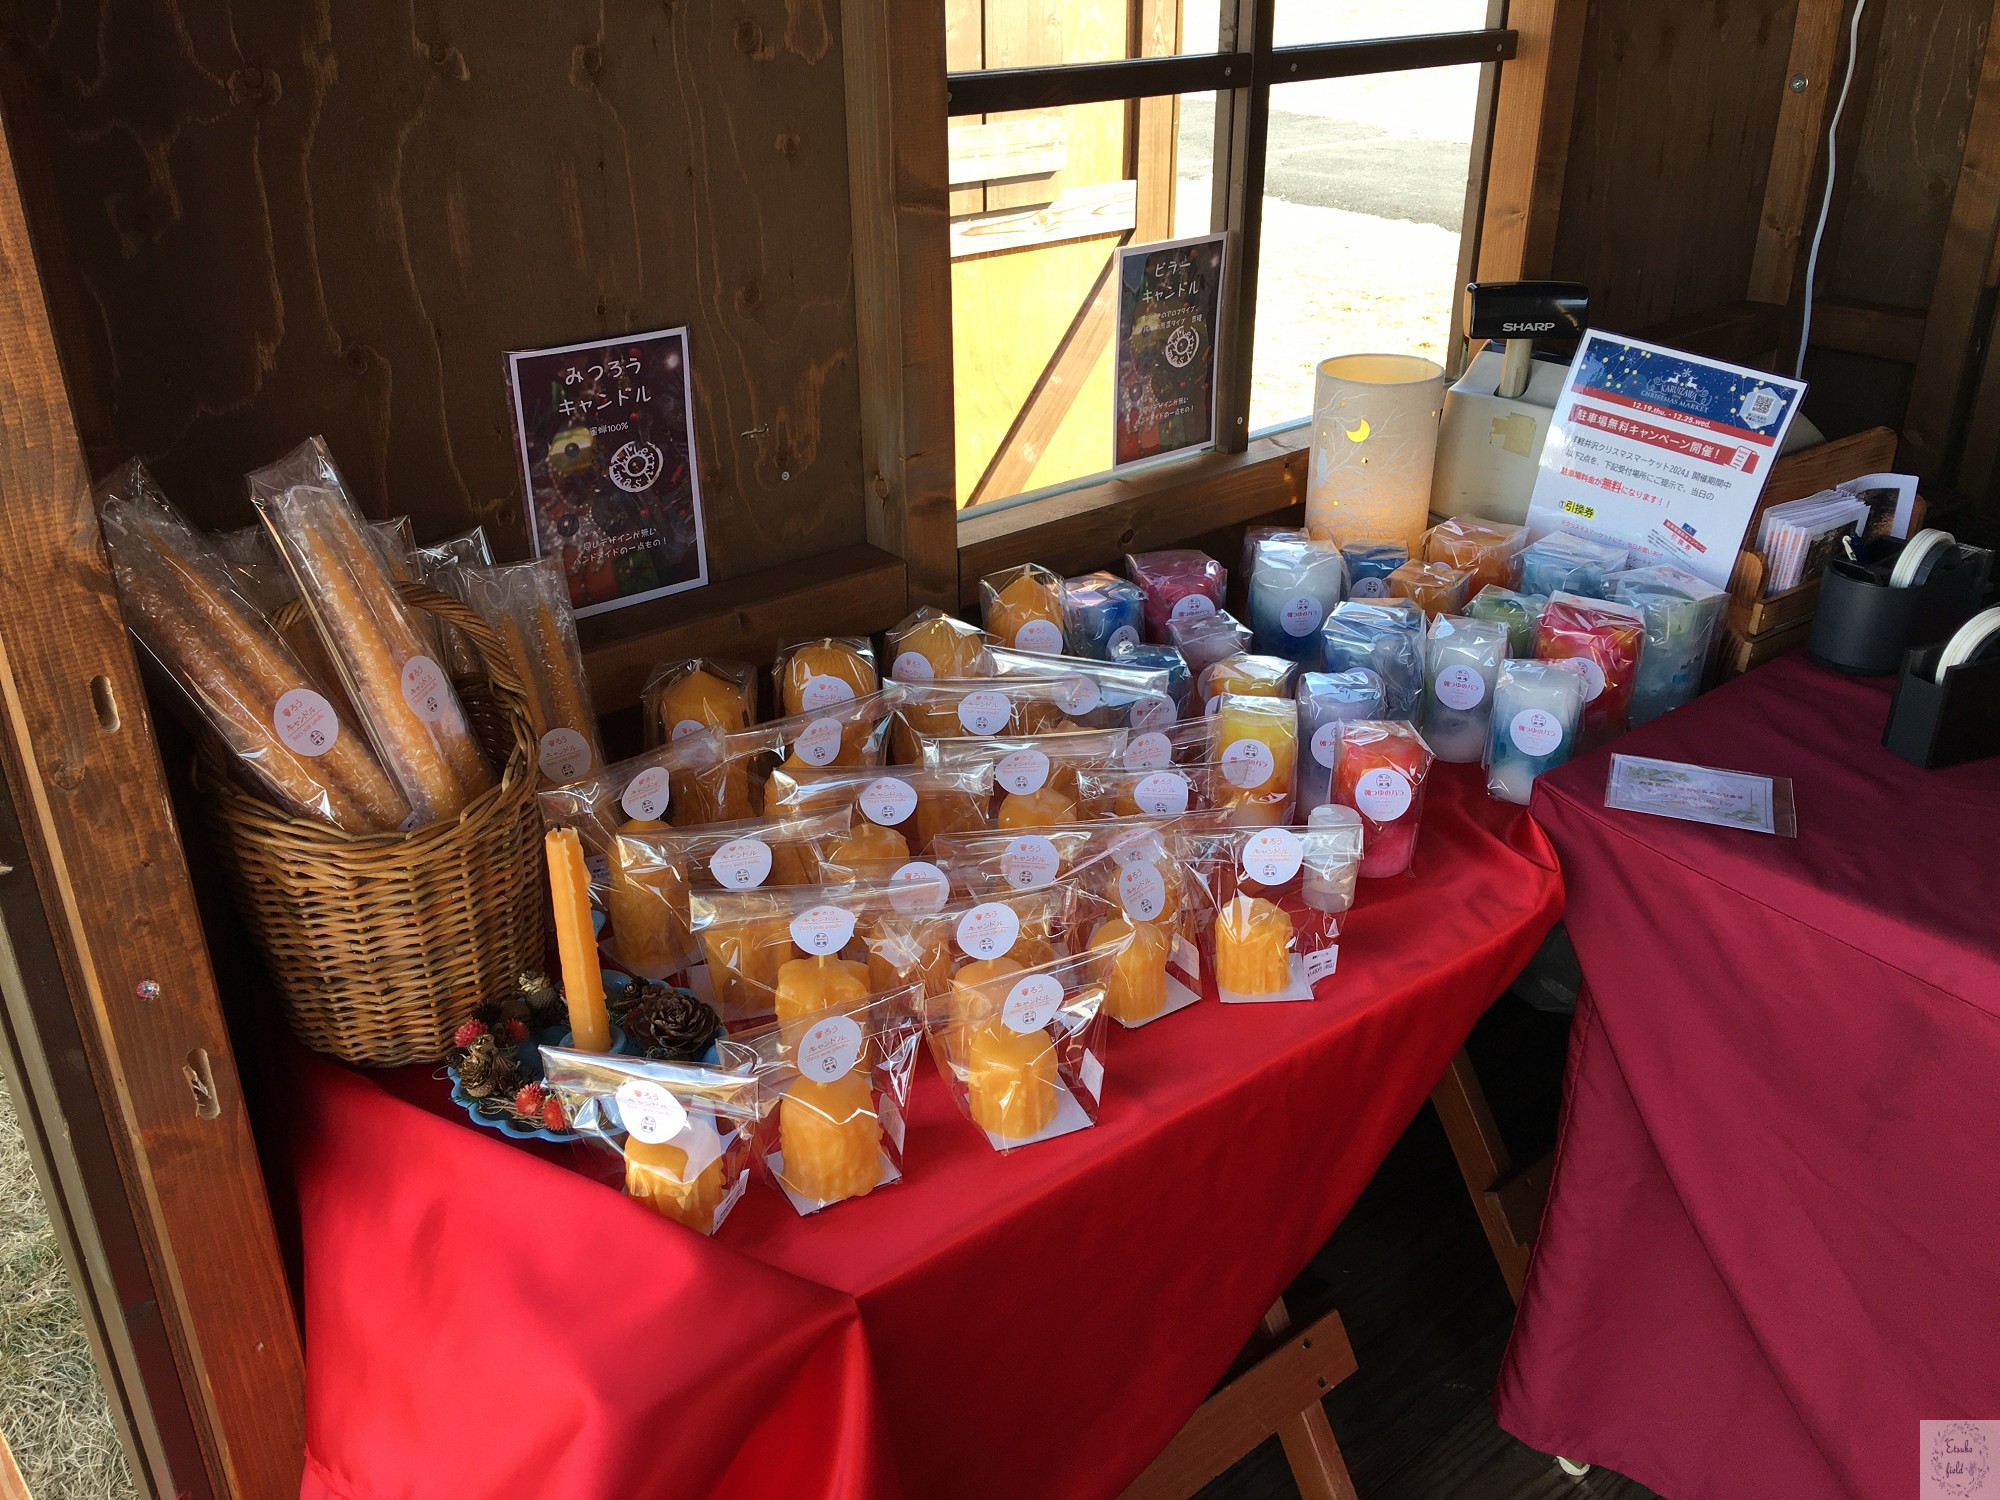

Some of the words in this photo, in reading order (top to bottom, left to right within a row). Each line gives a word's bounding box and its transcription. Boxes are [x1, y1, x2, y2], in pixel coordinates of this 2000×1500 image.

[1154, 260, 1191, 278] ピラー
[1142, 280, 1199, 303] キャンドル
[1502, 322, 1556, 331] SHARP
[565, 358, 641, 385] みつろう
[559, 386, 651, 416] キャンドル
[1640, 389, 1678, 404] CHRISTMAS
[1679, 400, 1710, 413] MARKET
[1660, 384, 1697, 401] KARUIZAWA
[1576, 408, 1721, 459] 駐車場無料キャンペーン開催！
